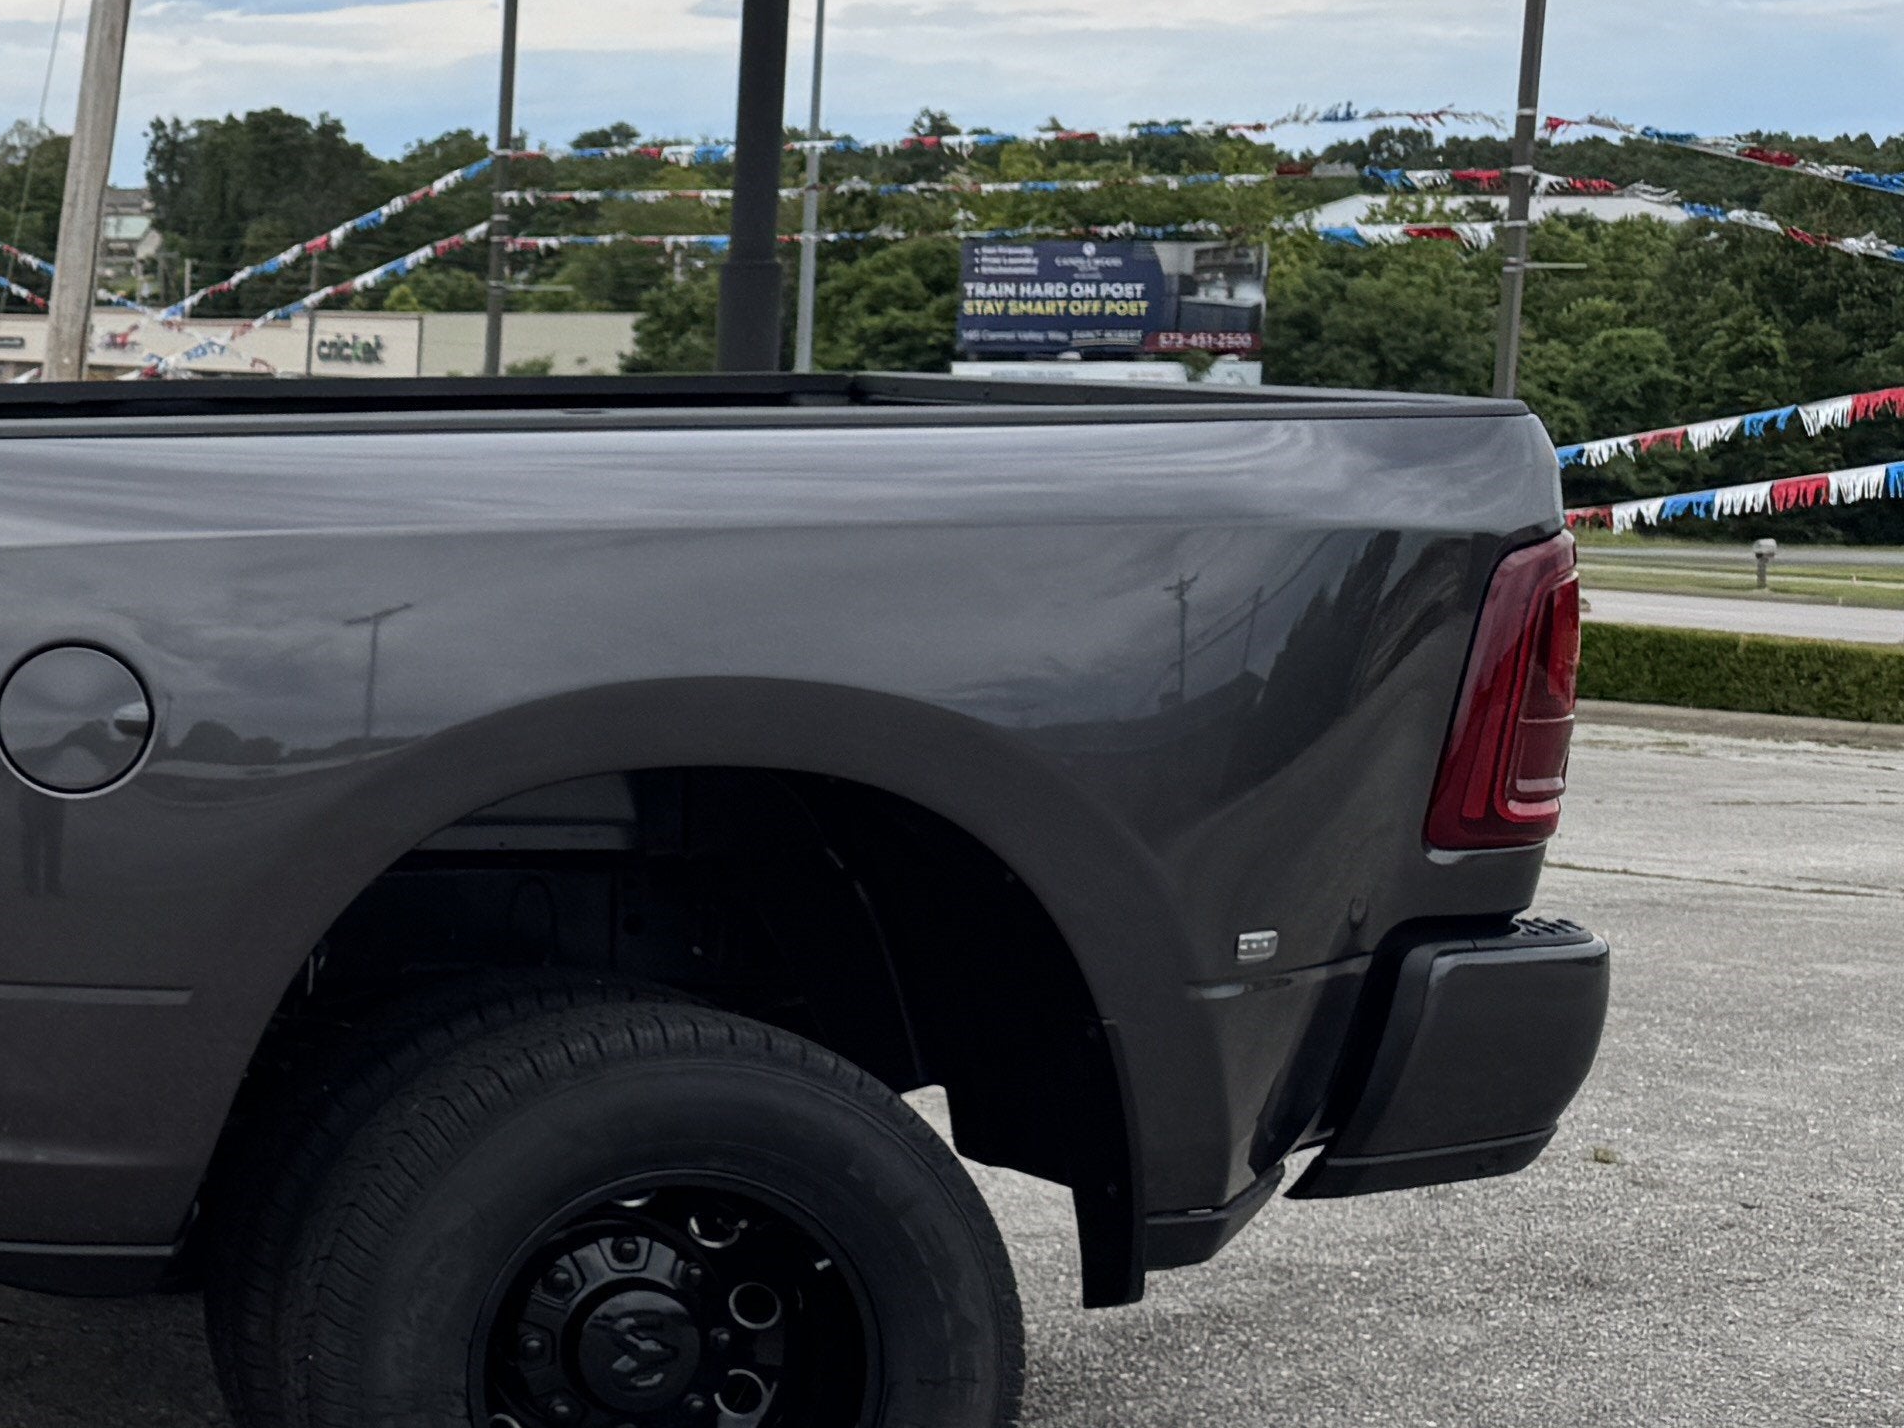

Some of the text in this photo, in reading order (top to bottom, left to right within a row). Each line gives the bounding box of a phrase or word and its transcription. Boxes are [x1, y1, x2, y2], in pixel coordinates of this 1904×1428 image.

[963, 282, 1145, 299] TRAIN HARD ON POST
[963, 300, 1149, 316] STAY SMART OFF POST
